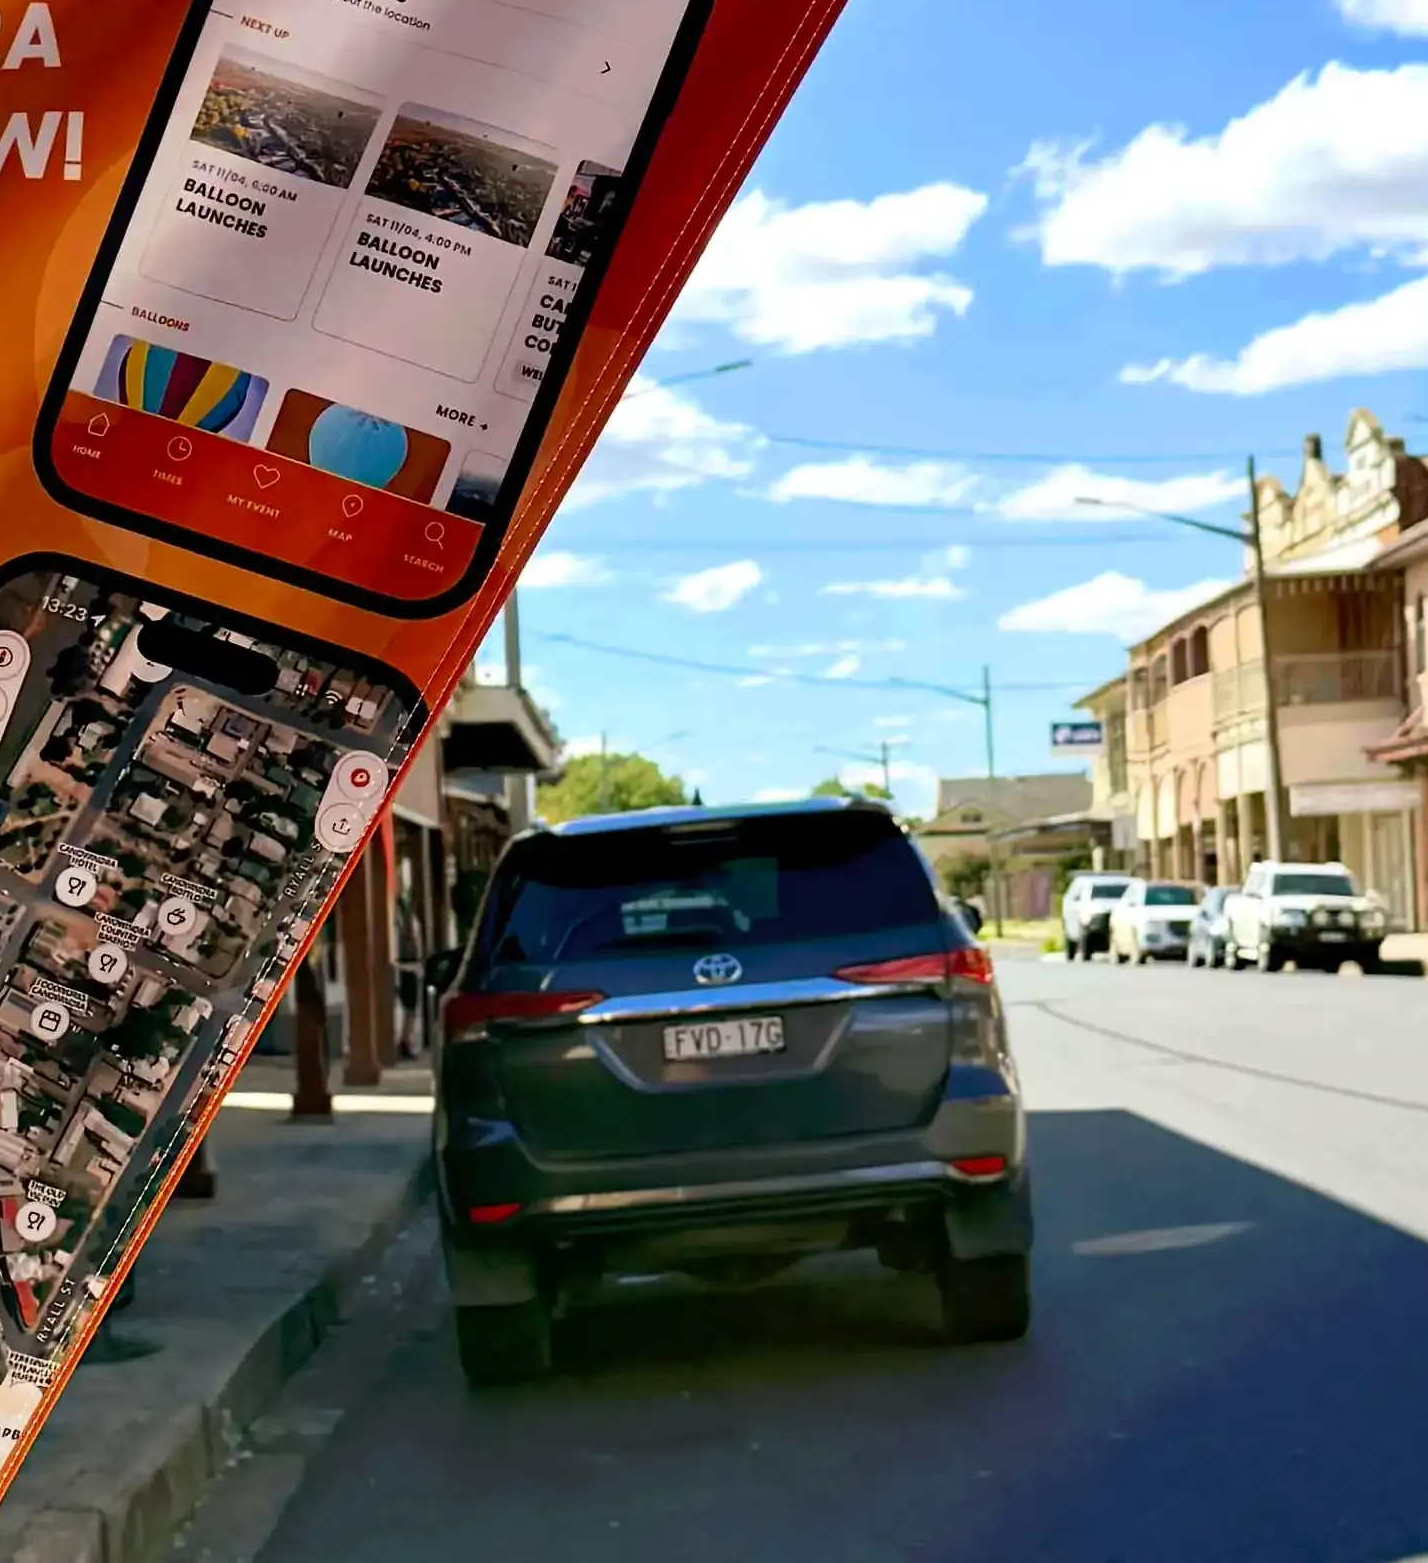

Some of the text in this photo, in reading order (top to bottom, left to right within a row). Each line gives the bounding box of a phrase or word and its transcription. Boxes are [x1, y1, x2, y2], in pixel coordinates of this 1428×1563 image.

[239, 15, 290, 39] NEXT UP
[362, 0, 383, 15] the
[384, 6, 431, 32] location
[191, 160, 215, 175] SAT
[278, 189, 298, 202] AM
[183, 178, 267, 216] BALLOON
[175, 198, 268, 238] LAUNCHES
[366, 213, 389, 228] SAT
[424, 233, 452, 249] 4:00
[453, 242, 472, 257] PM
[357, 231, 440, 270] BALLOON
[349, 251, 443, 294] LAUNCHES
[547, 275, 571, 291] SAT
[539, 294, 568, 315] CA
[131, 306, 190, 333] BALLOONS
[435, 404, 476, 427] MORE
[72, 444, 101, 460] HOME
[227, 493, 281, 519] MY EVENT
[403, 554, 445, 574] SEARCH
[42, 595, 88, 622] 13:23
[283, 856, 315, 897] RYALL
[37, 1278, 76, 1343] RYALL ST
